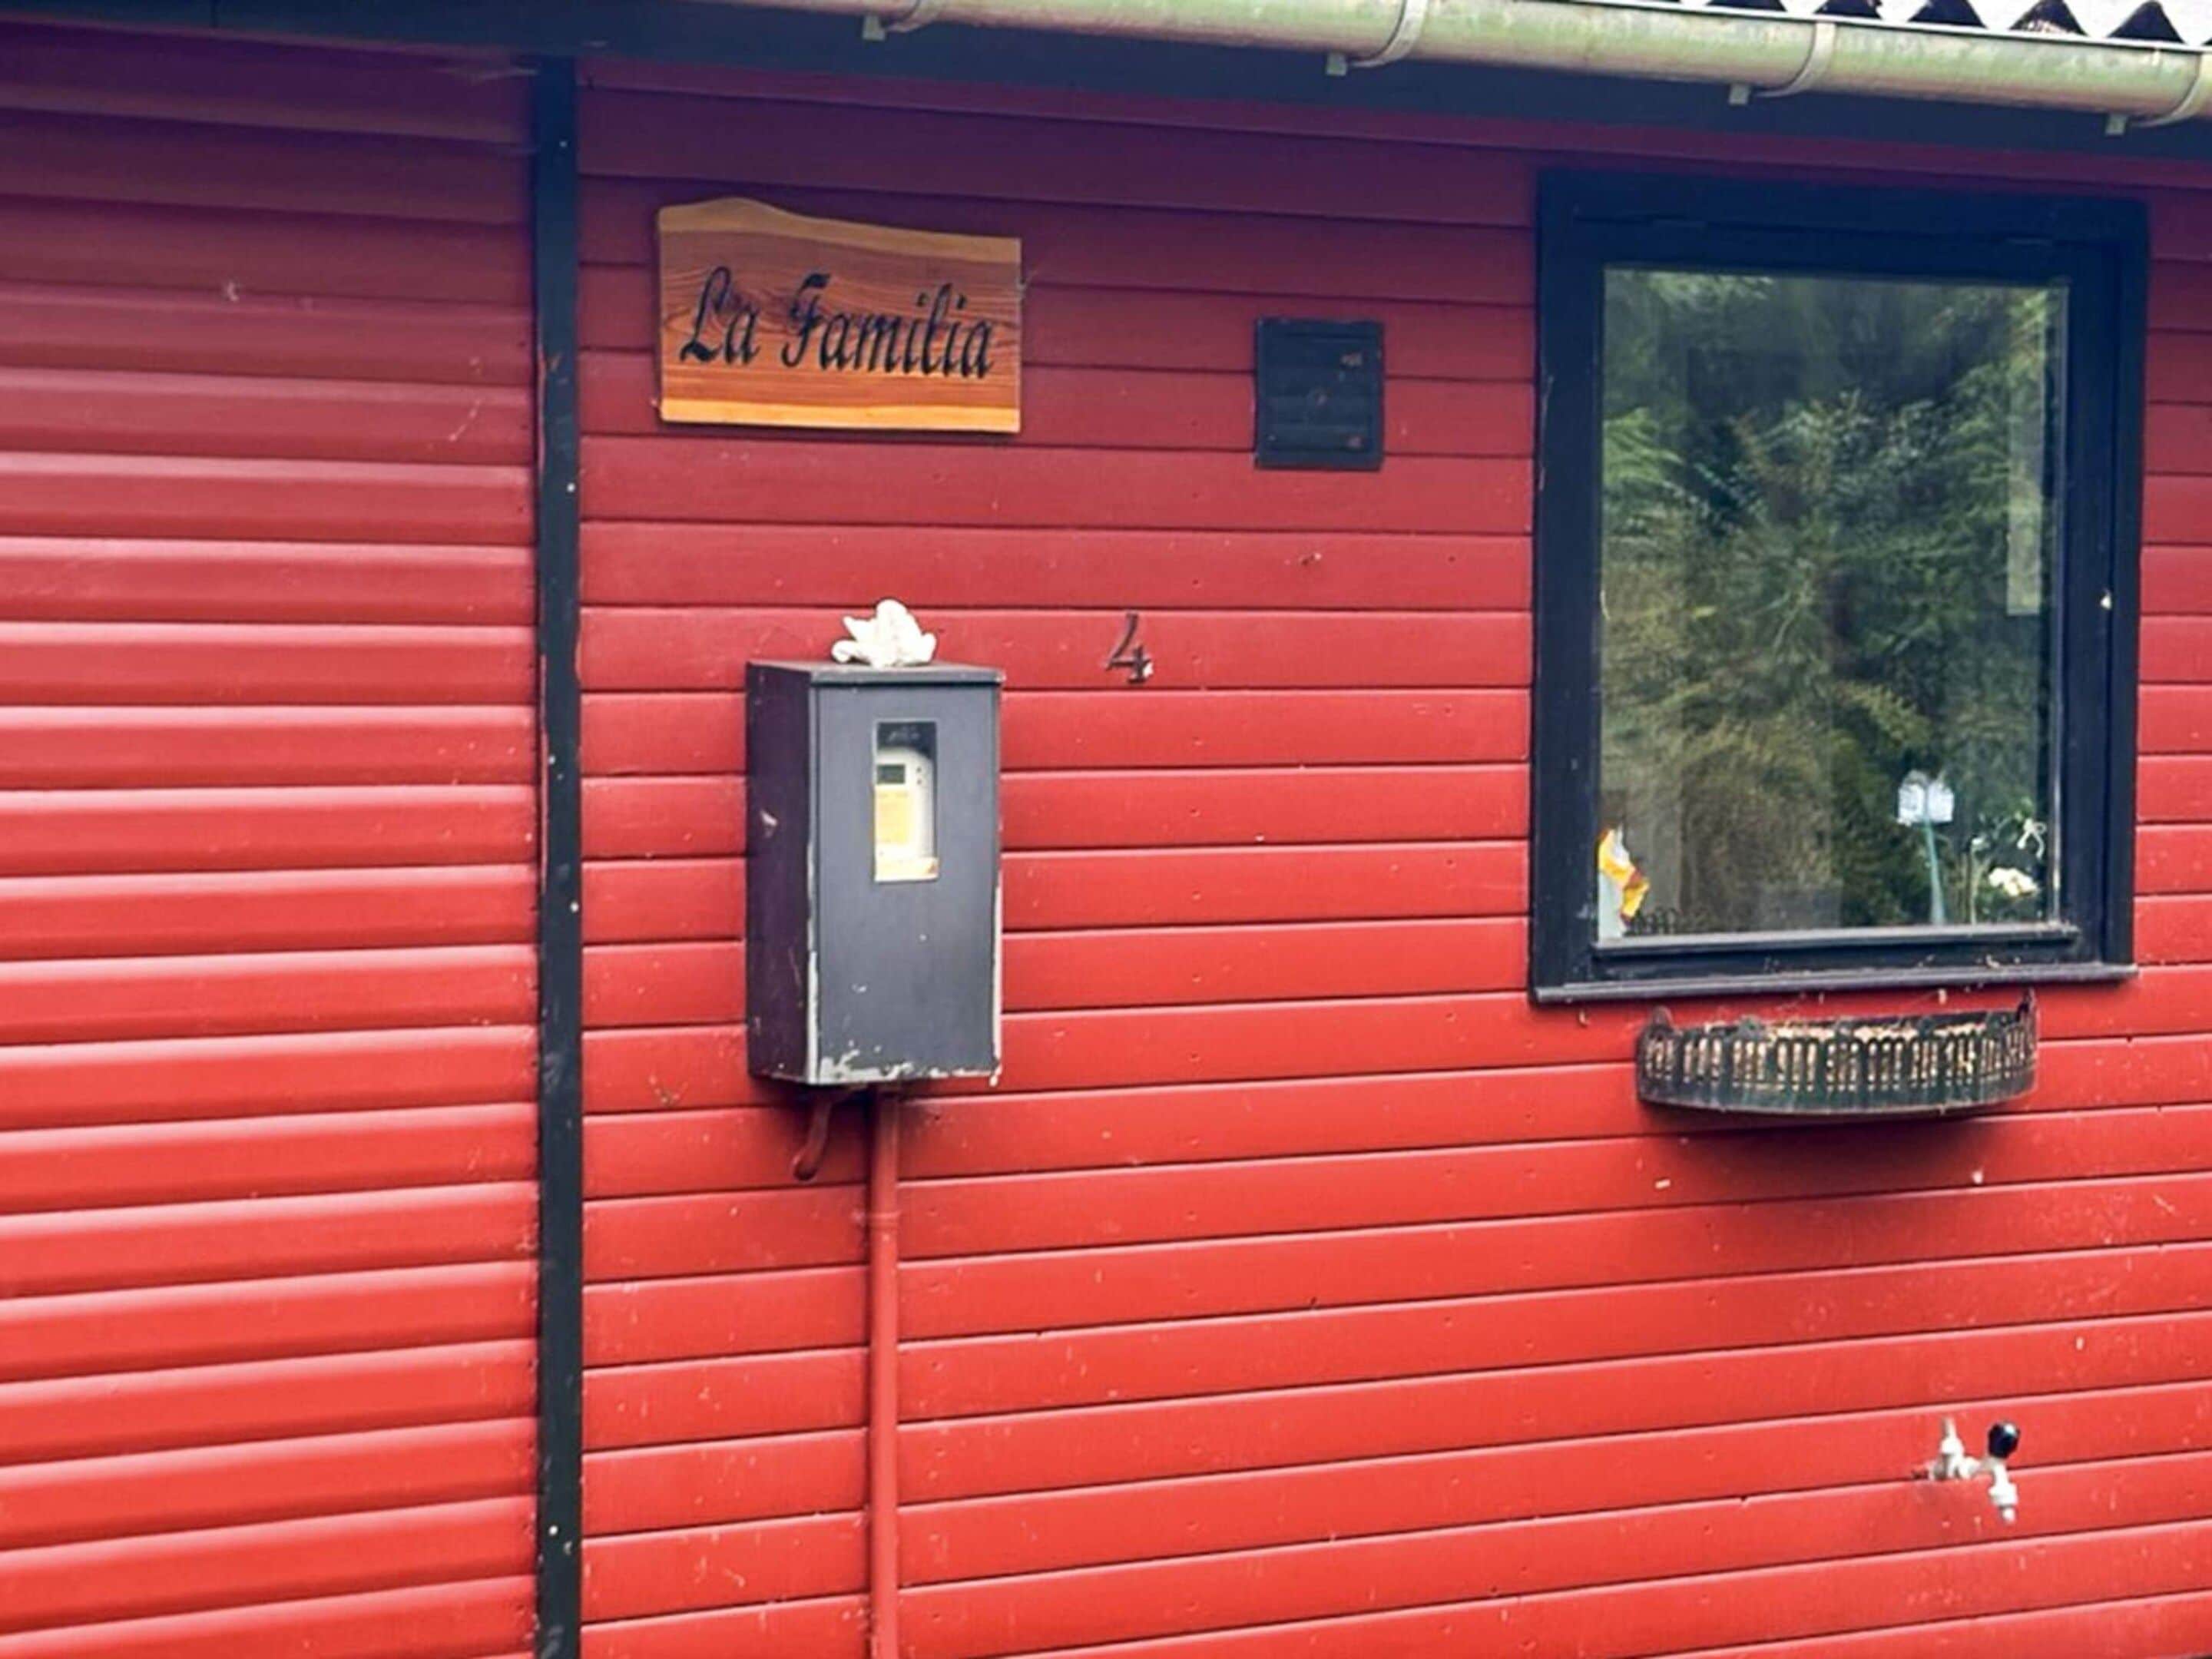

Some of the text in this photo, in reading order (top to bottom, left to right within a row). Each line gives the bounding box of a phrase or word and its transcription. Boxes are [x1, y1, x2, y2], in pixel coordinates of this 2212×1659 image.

[680, 266, 994, 379] La Familia
[1105, 612, 1152, 684] 4
